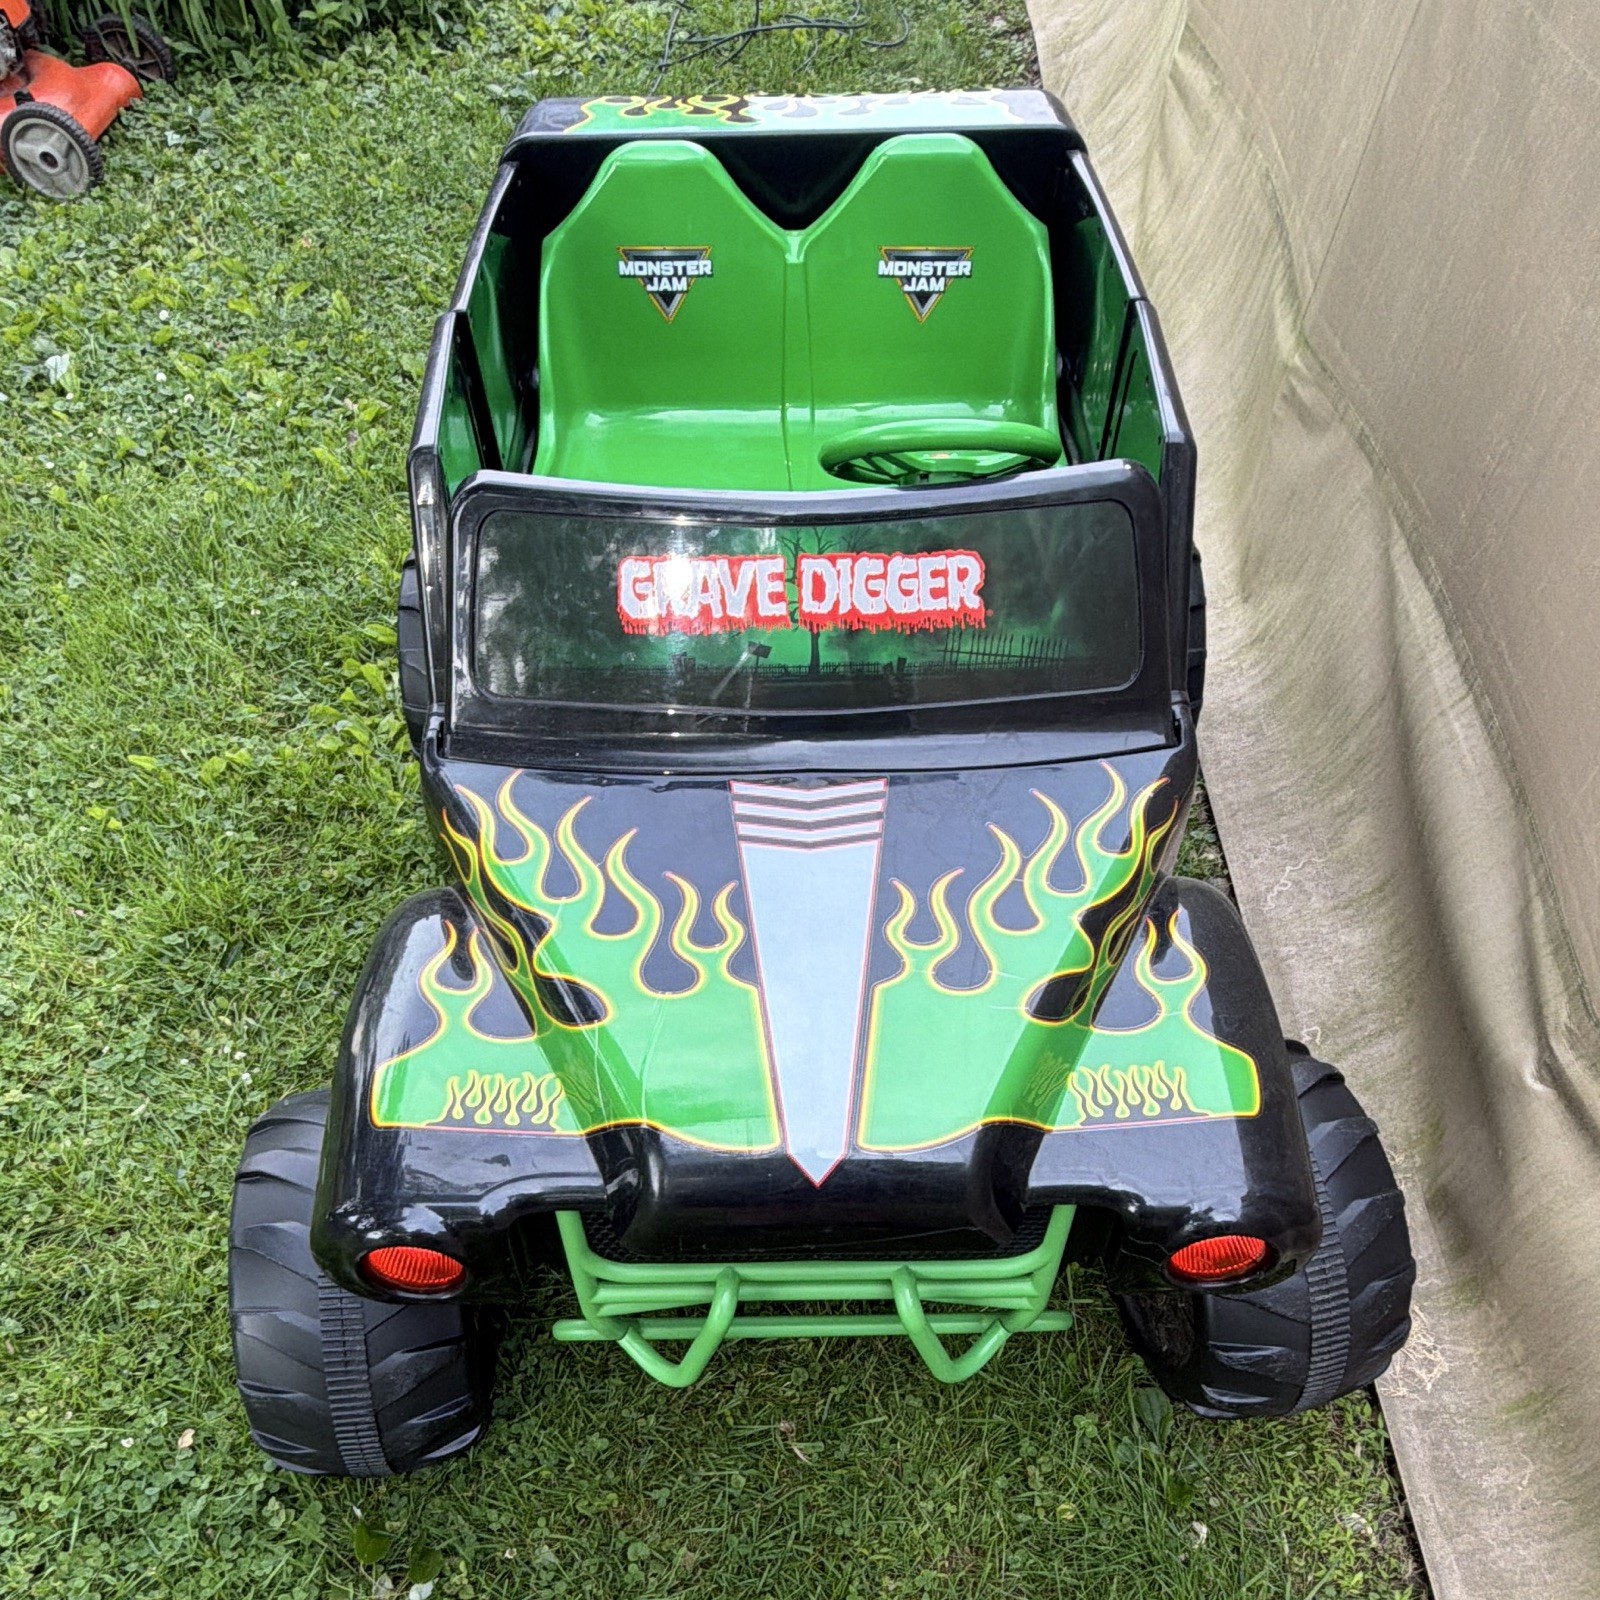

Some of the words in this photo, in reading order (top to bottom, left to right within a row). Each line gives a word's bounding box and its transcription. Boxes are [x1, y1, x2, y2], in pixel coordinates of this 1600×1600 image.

[618, 260, 712, 276] MONSTER
[878, 260, 971, 276] MONSTER
[646, 277, 687, 291] JAM
[903, 277, 945, 292] JAM
[799, 552, 984, 625] DIGGER
